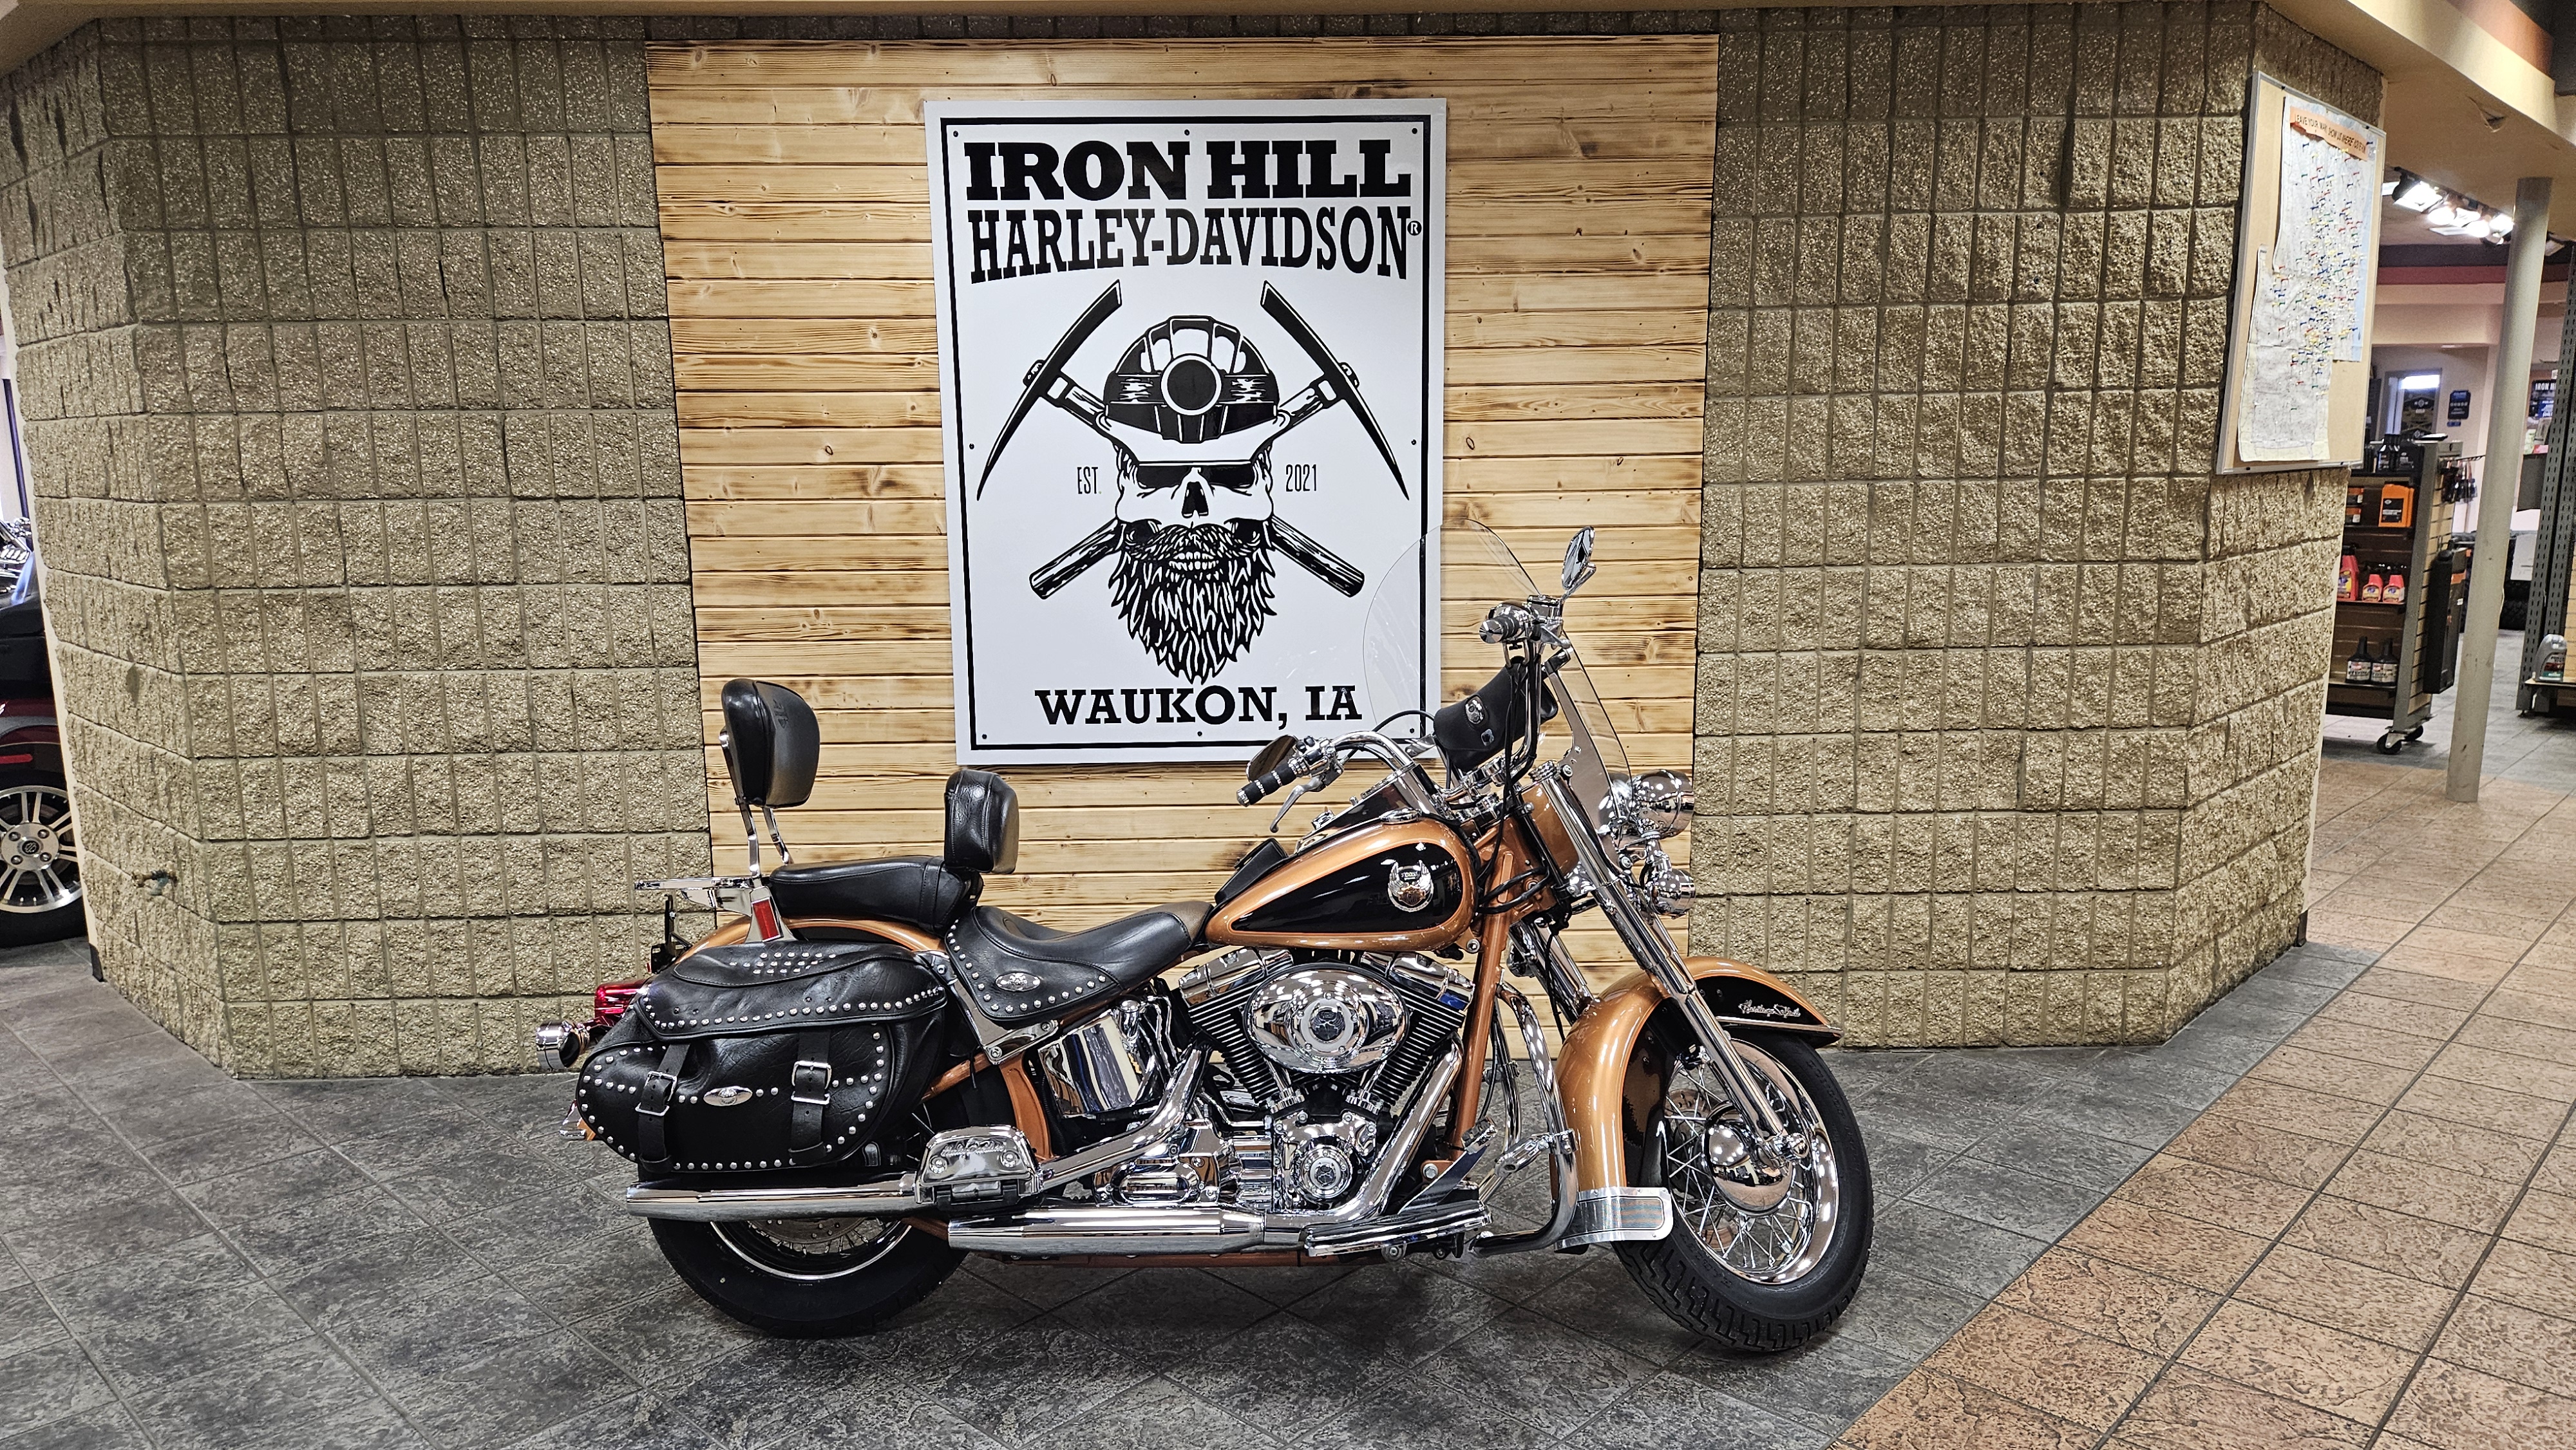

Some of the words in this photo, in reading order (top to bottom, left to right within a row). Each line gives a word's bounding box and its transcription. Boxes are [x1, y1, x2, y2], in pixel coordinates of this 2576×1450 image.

[963, 140, 1191, 202] IRON
[1206, 139, 1412, 200] HILL
[2535, 382, 2549, 391] IRON
[1077, 466, 1102, 494] EST.
[1285, 464, 1318, 492] 2021
[1034, 684, 1287, 731] WAUKON,
[1305, 685, 1363, 721] IA
